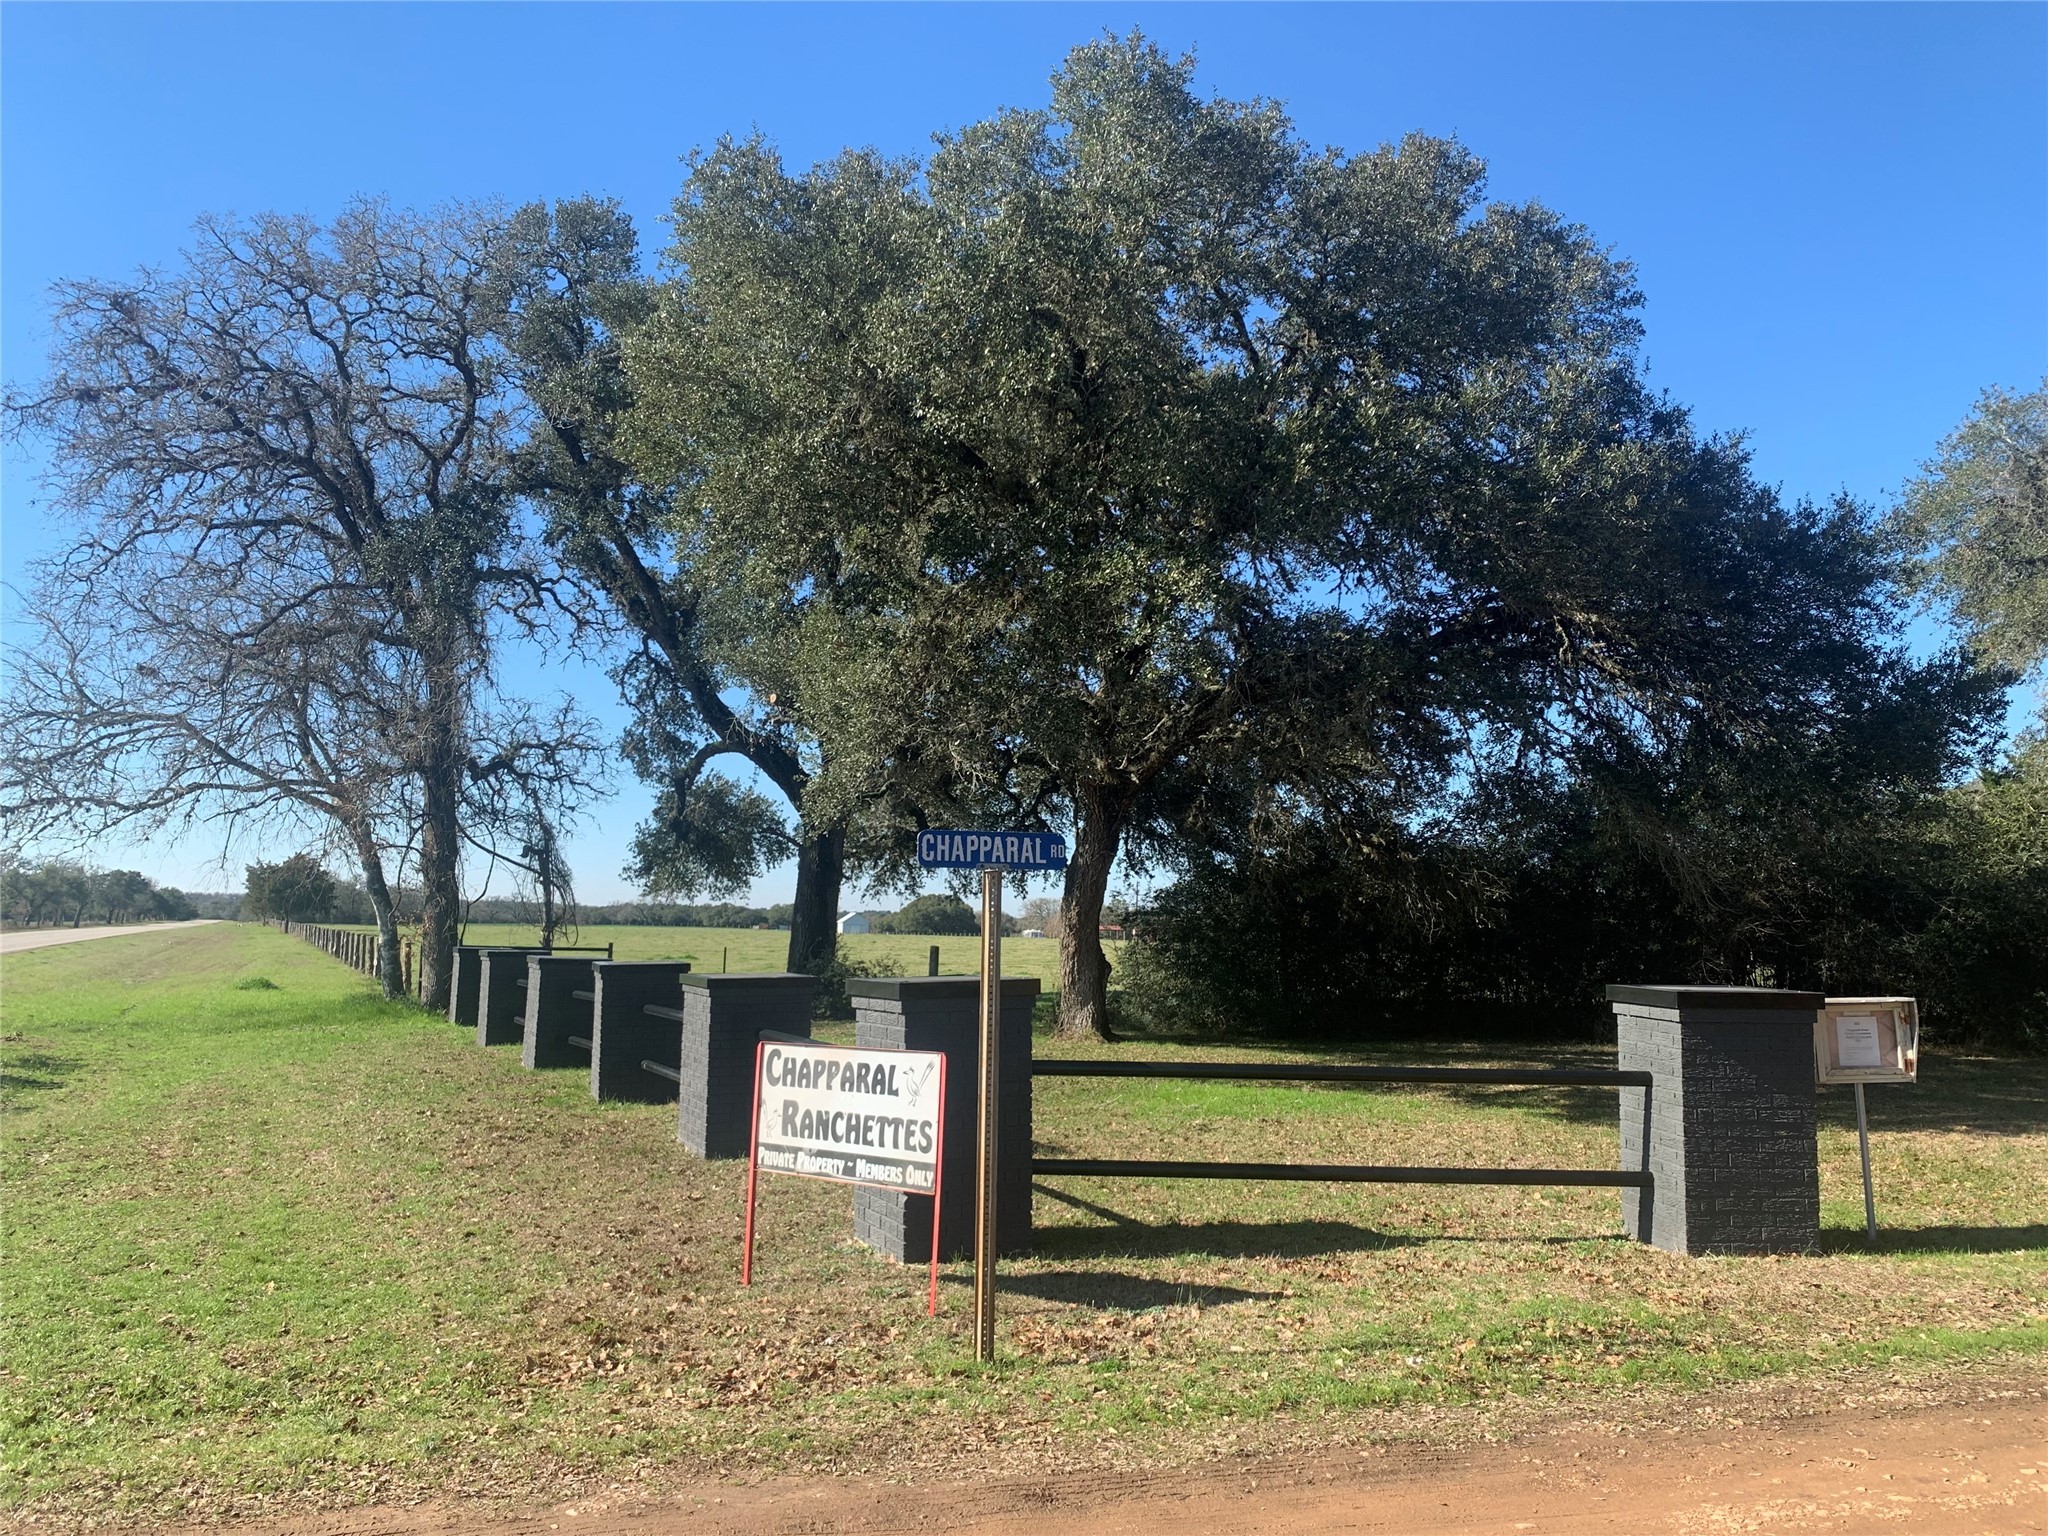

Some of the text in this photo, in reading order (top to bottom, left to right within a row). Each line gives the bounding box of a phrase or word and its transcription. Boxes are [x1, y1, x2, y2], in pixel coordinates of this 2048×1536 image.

[922, 833, 1065, 864] CHAPPARAL RD
[765, 1048, 899, 1097] CHAPPARAL
[781, 1099, 933, 1154] RANCHETTES
[757, 1147, 795, 1169] PRIVATE
[796, 1151, 845, 1176] PROPERTY
[855, 1158, 903, 1184] MEMBERS
[905, 1164, 934, 1188] ONLY
